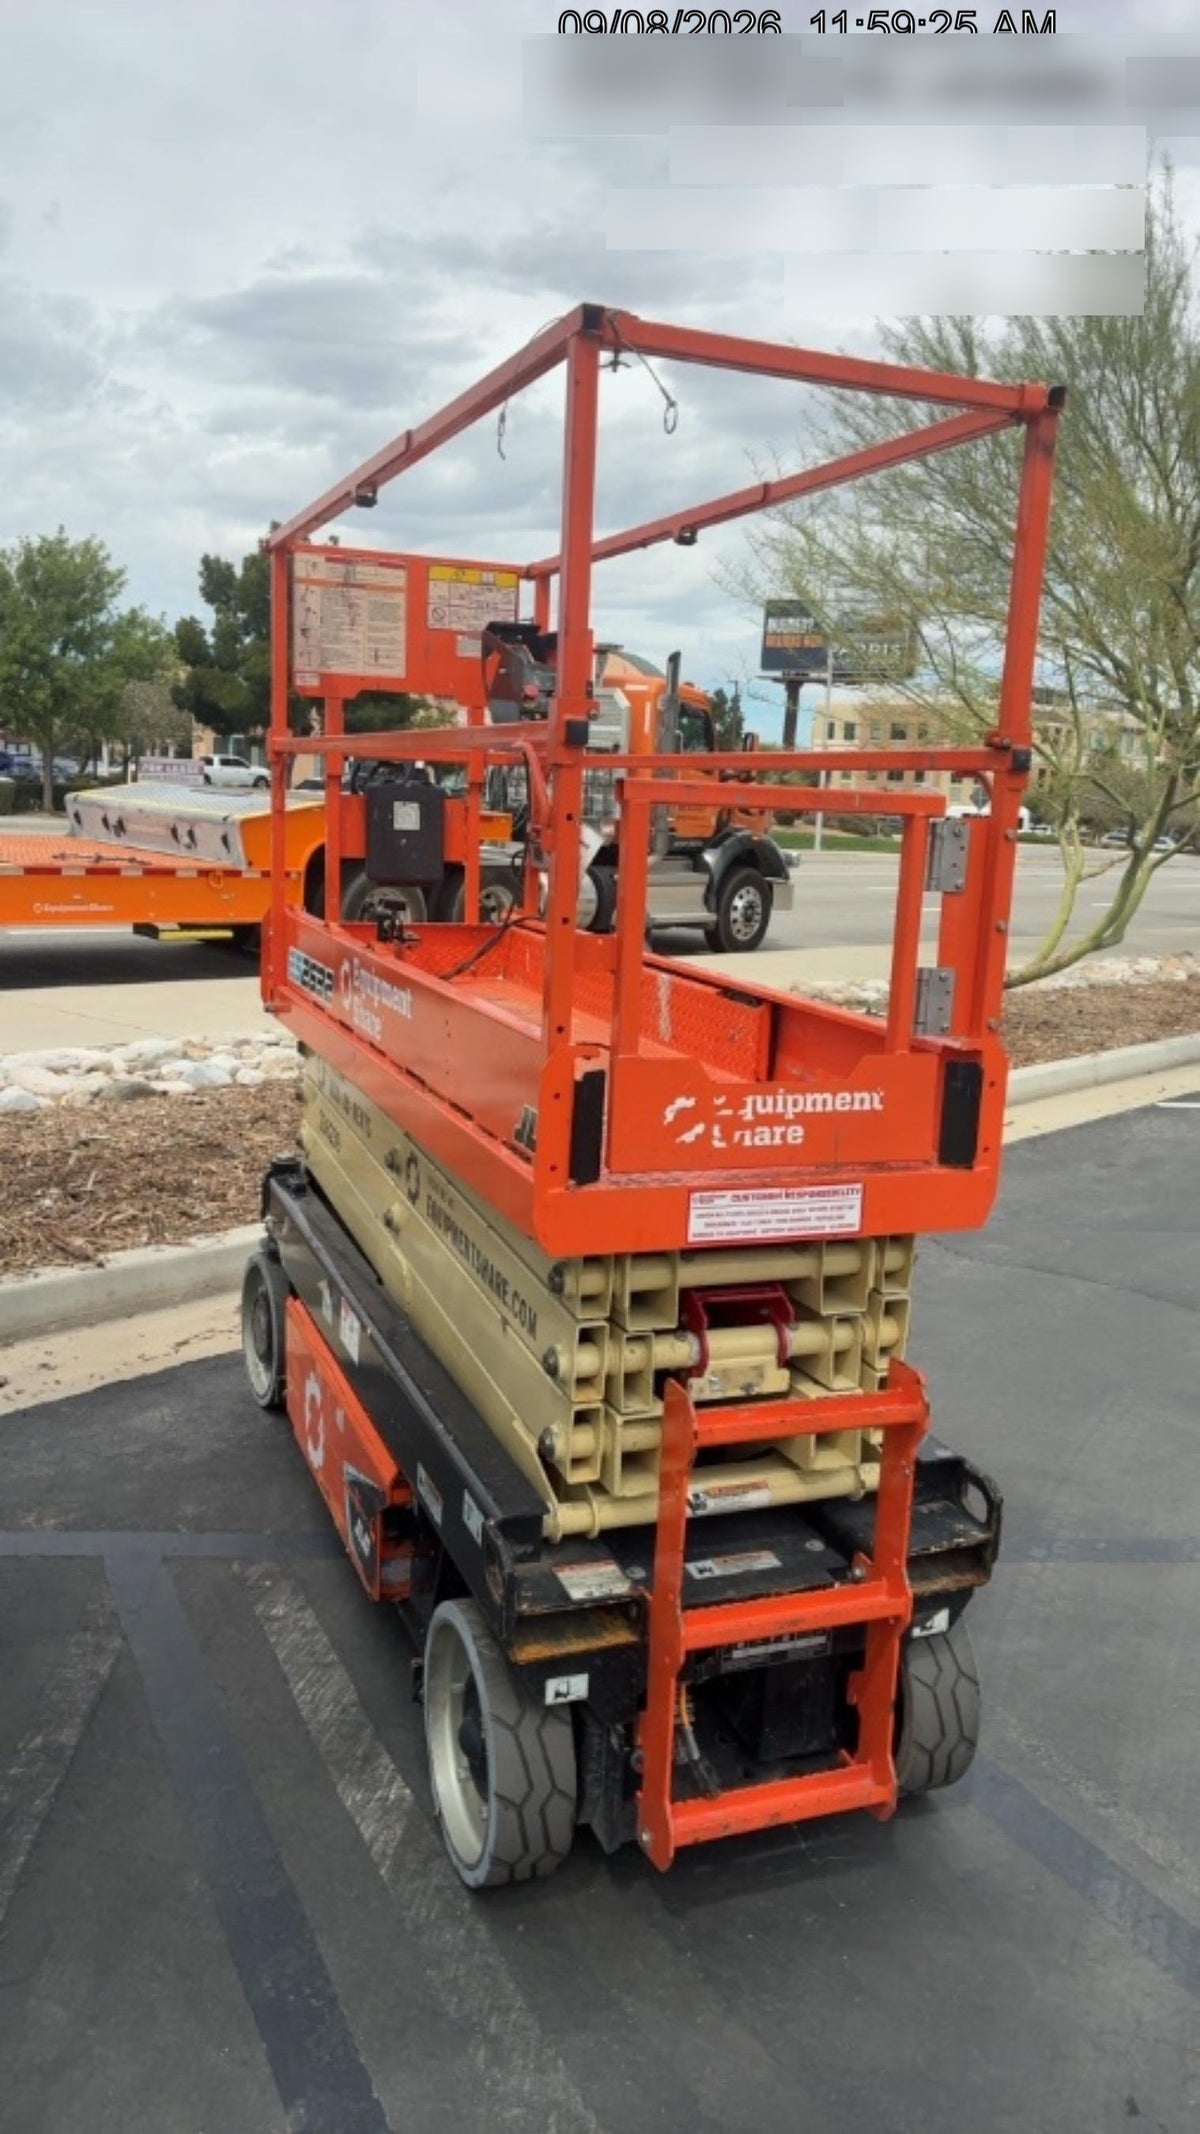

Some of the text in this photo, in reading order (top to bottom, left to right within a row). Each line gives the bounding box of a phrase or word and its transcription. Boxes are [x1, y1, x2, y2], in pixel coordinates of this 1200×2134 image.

[352, 957, 413, 1020] Equipment
[352, 996, 382, 1042] Share
[426, 1194, 538, 1340] EQUIPMENTSHARE.COM
